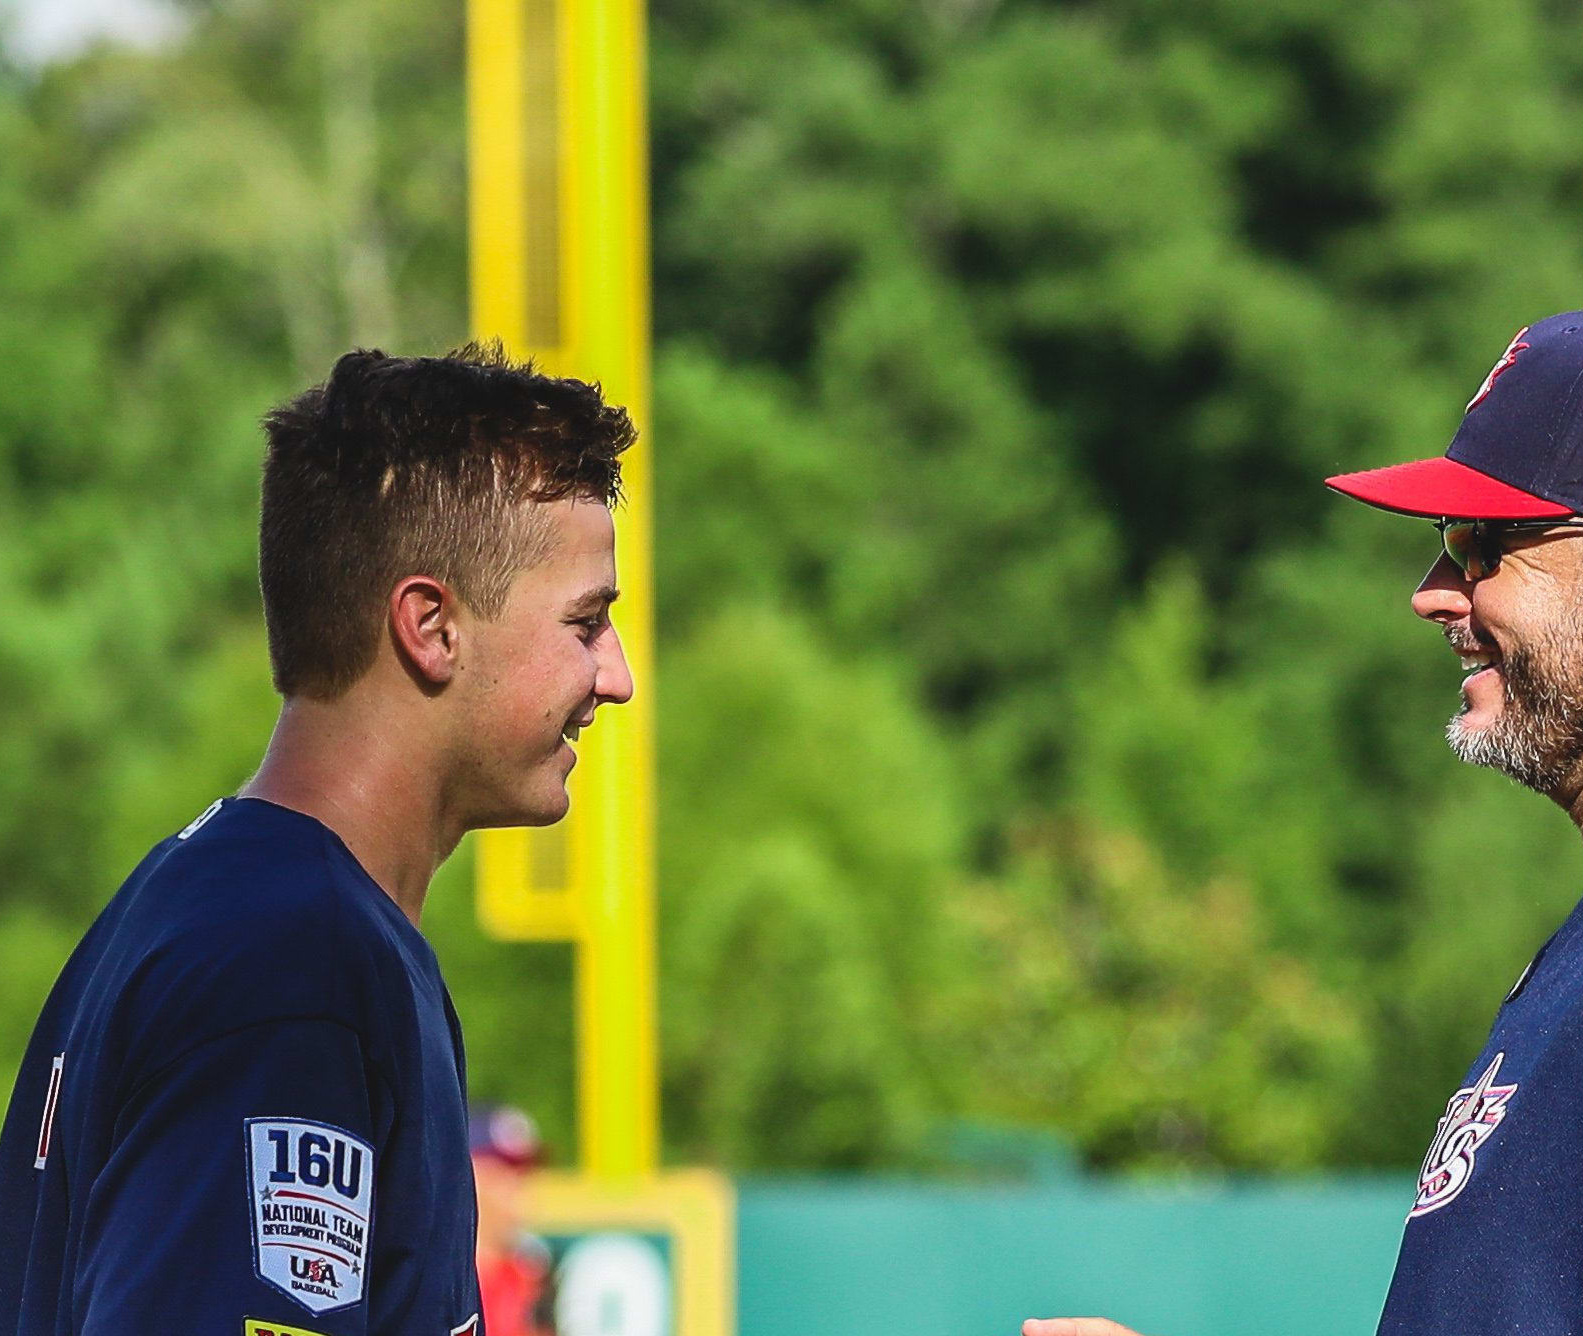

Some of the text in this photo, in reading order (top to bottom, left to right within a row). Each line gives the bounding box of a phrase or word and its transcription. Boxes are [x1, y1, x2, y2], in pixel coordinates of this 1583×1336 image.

[267, 1129, 363, 1200] 16U
[262, 1204, 363, 1244] NATIONAL TEAM
[263, 1224, 324, 1241] DEVELOPMENT
[291, 1280, 338, 1300] BASEBALL
